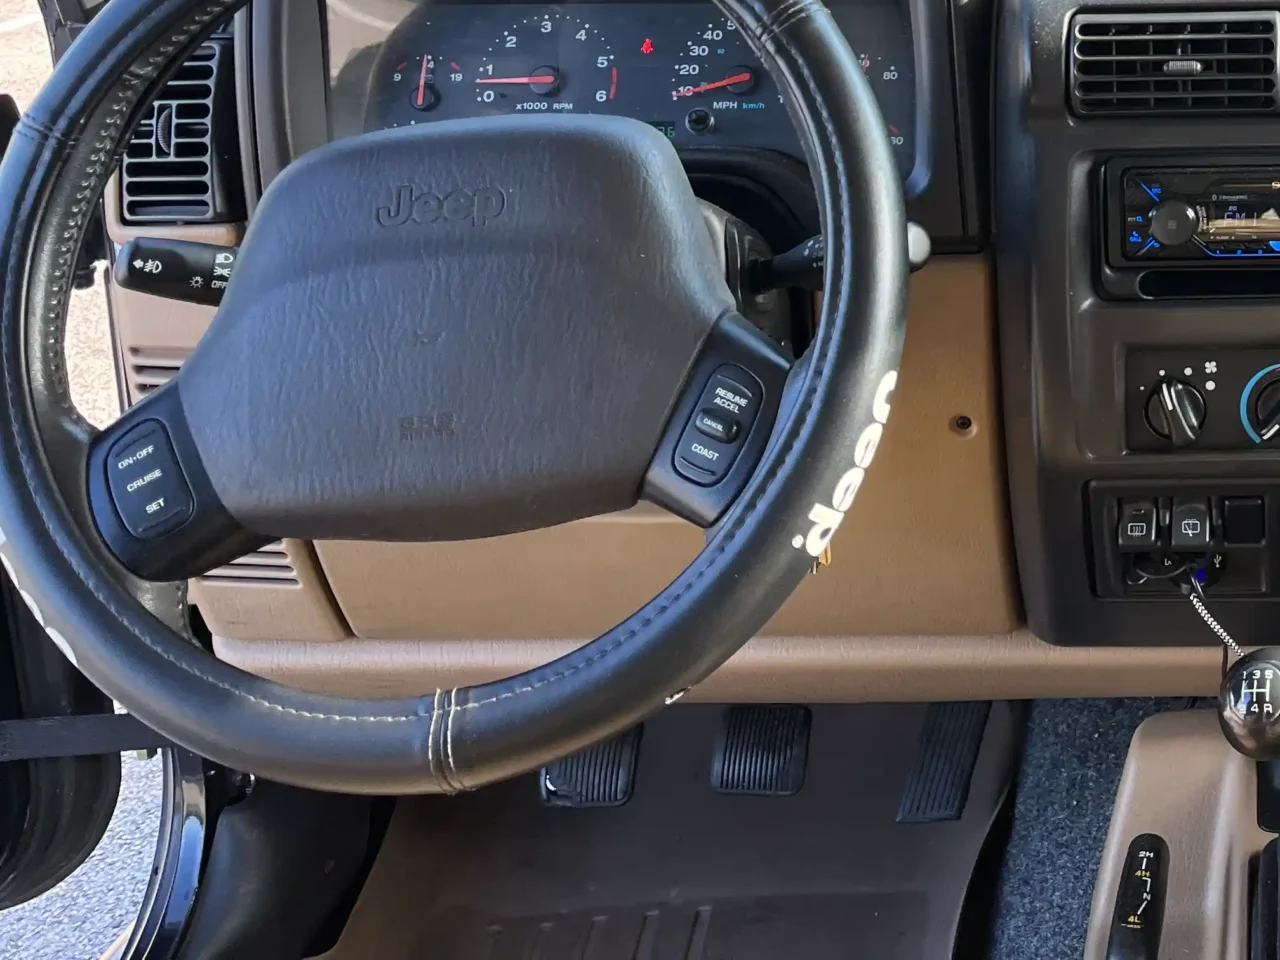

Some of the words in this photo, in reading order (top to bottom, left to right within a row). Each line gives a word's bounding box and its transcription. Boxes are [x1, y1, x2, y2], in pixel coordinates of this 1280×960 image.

[541, 21, 552, 33] 3
[575, 29, 587, 41] 4
[702, 30, 724, 41] 40
[505, 36, 517, 48] 2
[689, 45, 709, 56] 30
[597, 56, 608, 68] 5
[486, 64, 493, 76] 1
[679, 64, 700, 75] 20
[393, 73, 402, 82] 9
[450, 73, 463, 82] 19
[883, 71, 898, 80] 80
[483, 91, 495, 103] 0
[595, 90, 607, 102] 6
[678, 86, 694, 97] 10
[515, 102, 548, 111] x1000
[713, 101, 738, 109] MPH
[742, 102, 766, 110] km/h
[376, 184, 507, 228] Jeep
[211, 280, 228, 290] OFF
[715, 387, 749, 408] RESUME
[713, 396, 740, 414] ACCEL
[703, 418, 724, 432] CANCEL
[691, 443, 720, 461] COAST
[126, 468, 164, 493] CRUISE
[145, 497, 165, 515] SET
[1252, 670, 1261, 679] 3
[1264, 670, 1274, 679] 5
[1250, 703, 1260, 713] 4
[1263, 703, 1273, 714] R
[1138, 850, 1154, 858] 2H
[1134, 870, 1150, 878] 4H
[1143, 892, 1151, 901] N
[1127, 915, 1143, 924] 4L
